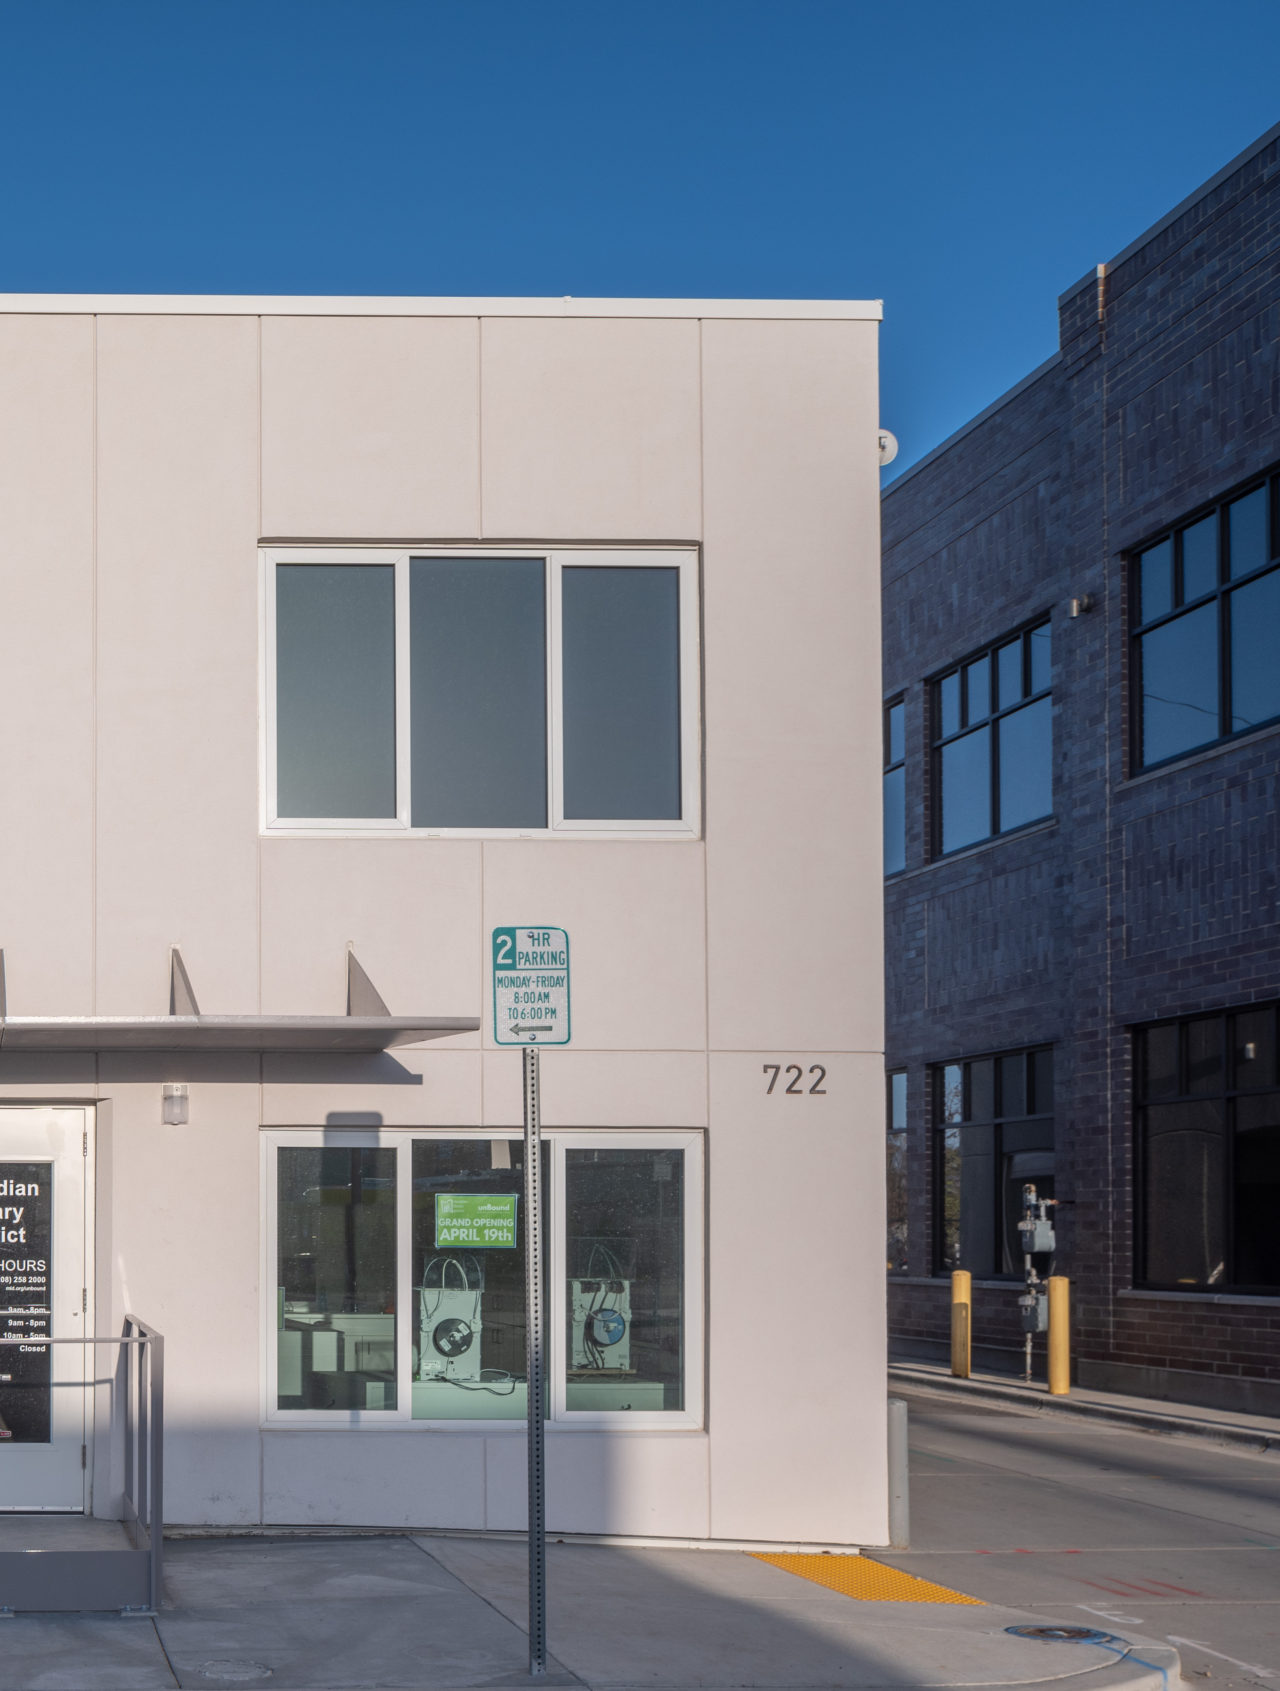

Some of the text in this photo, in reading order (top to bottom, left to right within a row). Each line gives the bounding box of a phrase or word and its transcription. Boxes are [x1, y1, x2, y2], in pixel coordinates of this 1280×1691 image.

[496, 932, 551, 964] 2 HR
[518, 951, 565, 966] PARKING
[497, 975, 565, 988] MONDAY-FRIDAY
[514, 992, 550, 1004] 8:00 AM
[508, 1007, 557, 1020] TO 6:00 PM
[763, 1064, 827, 1094] 722
[439, 1218, 514, 1227] GRAND OPENING
[440, 1228, 512, 1241] APRIL 19th
[29, 1306, 46, 1314] 8pm
[29, 1319, 46, 1327] 8pm
[19, 1344, 46, 1352] Closed
